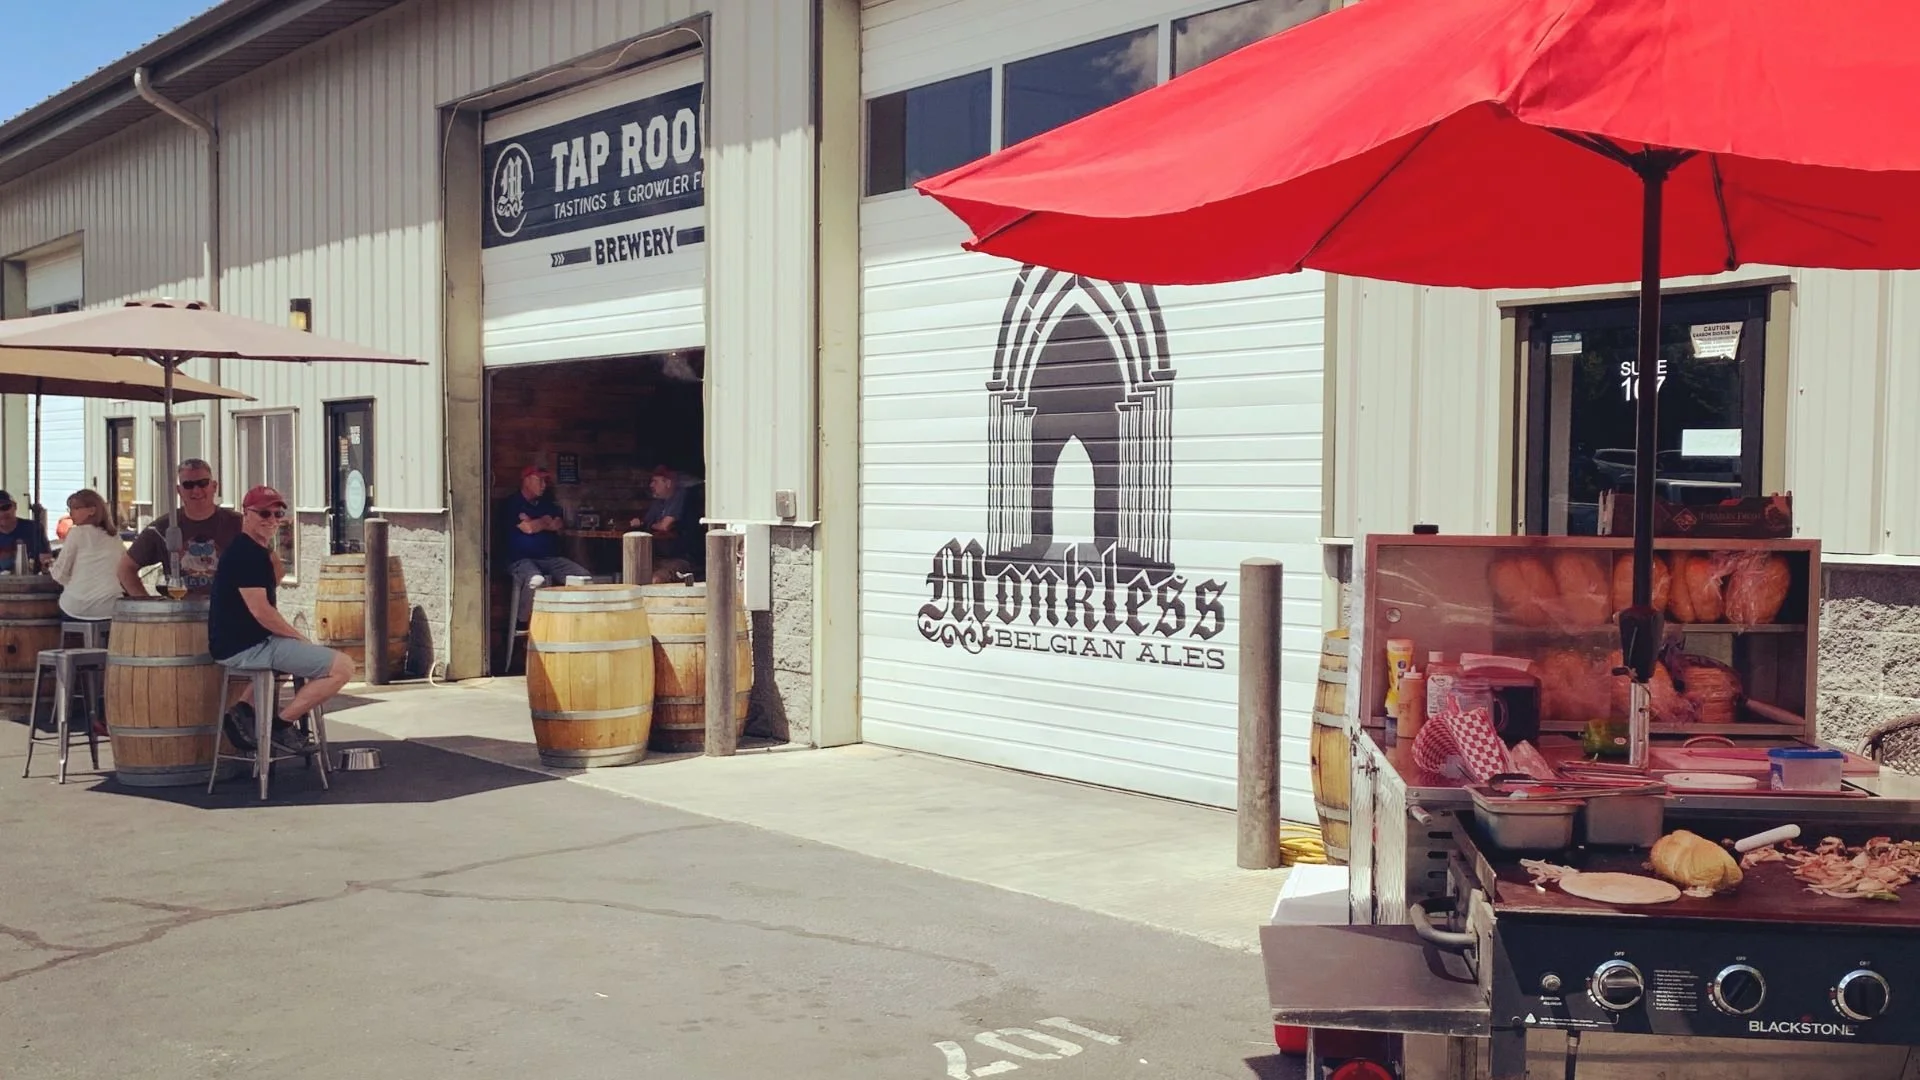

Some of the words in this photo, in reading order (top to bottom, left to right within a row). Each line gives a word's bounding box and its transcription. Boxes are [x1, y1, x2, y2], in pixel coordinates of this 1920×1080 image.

[551, 130, 610, 192] TAP
[621, 106, 704, 177] ROO
[554, 195, 607, 220] TASTINGS
[613, 190, 621, 207] &
[628, 173, 690, 203] GROWLER
[594, 226, 675, 266] BREWERY
[1704, 324, 1731, 332] CAUTION
[1620, 359, 1668, 377] SUE
[918, 537, 1228, 652] Monkless
[995, 628, 1126, 660] BELGIAN
[1136, 642, 1225, 669] ALES
[1749, 1020, 1857, 1036] BLACKSTONE
